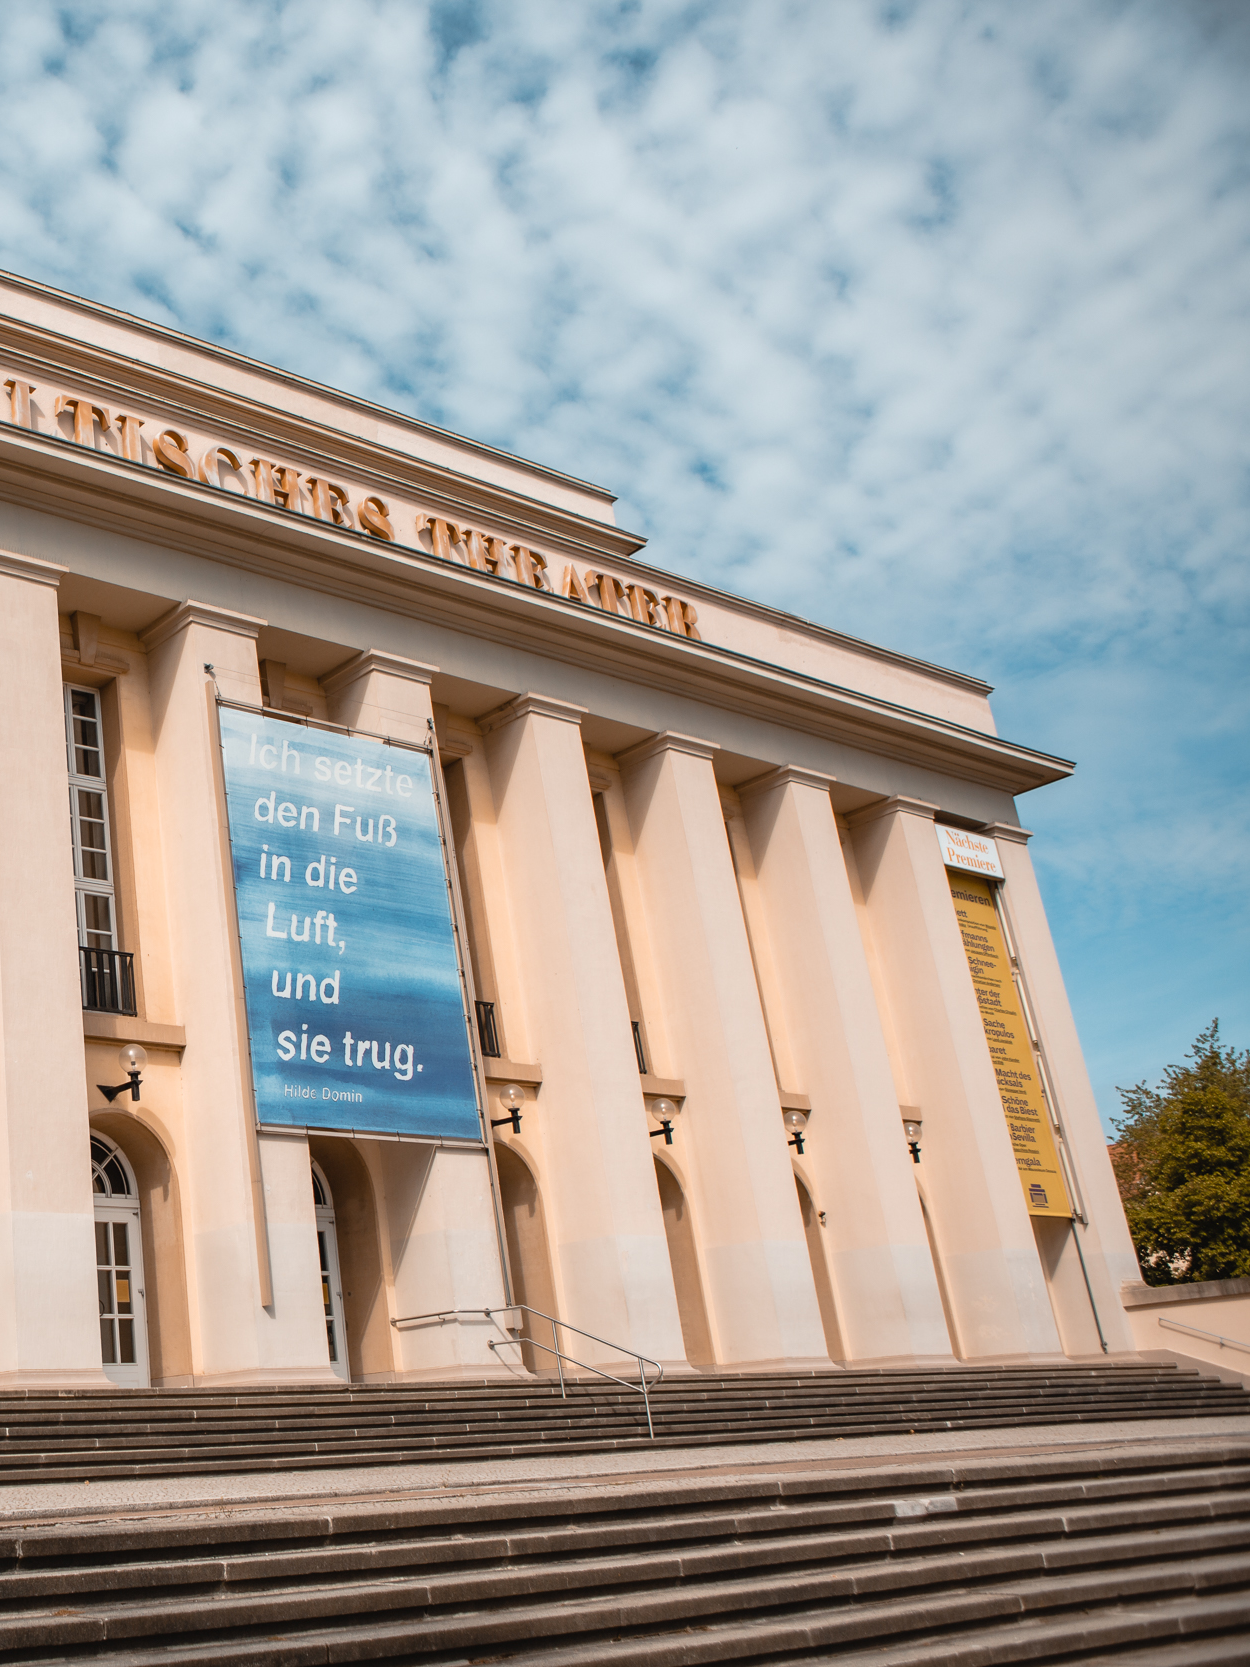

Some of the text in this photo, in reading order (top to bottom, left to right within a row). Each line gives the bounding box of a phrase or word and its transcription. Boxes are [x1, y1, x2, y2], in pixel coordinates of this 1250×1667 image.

[416, 513, 702, 641] THEATER
[248, 732, 415, 799] Ich setzte
[253, 790, 398, 848] den Fuß
[945, 828, 989, 855] Nächste
[259, 843, 359, 895] in die
[947, 847, 997, 873] Premiere
[265, 902, 347, 956] Luft,
[270, 969, 341, 1005] und
[984, 1018, 1005, 1030] Sache
[275, 1023, 424, 1082] sie trug.
[995, 1068, 1031, 1082] Macht des
[284, 1084, 363, 1103] Hilde Domin
[1002, 1095, 1028, 1107] Schöne
[1007, 1104, 1019, 1114] das
[1021, 1106, 1038, 1117] Biest
[1011, 1123, 1035, 1134] Barbier
[1012, 1132, 1036, 1143] Sevilla
